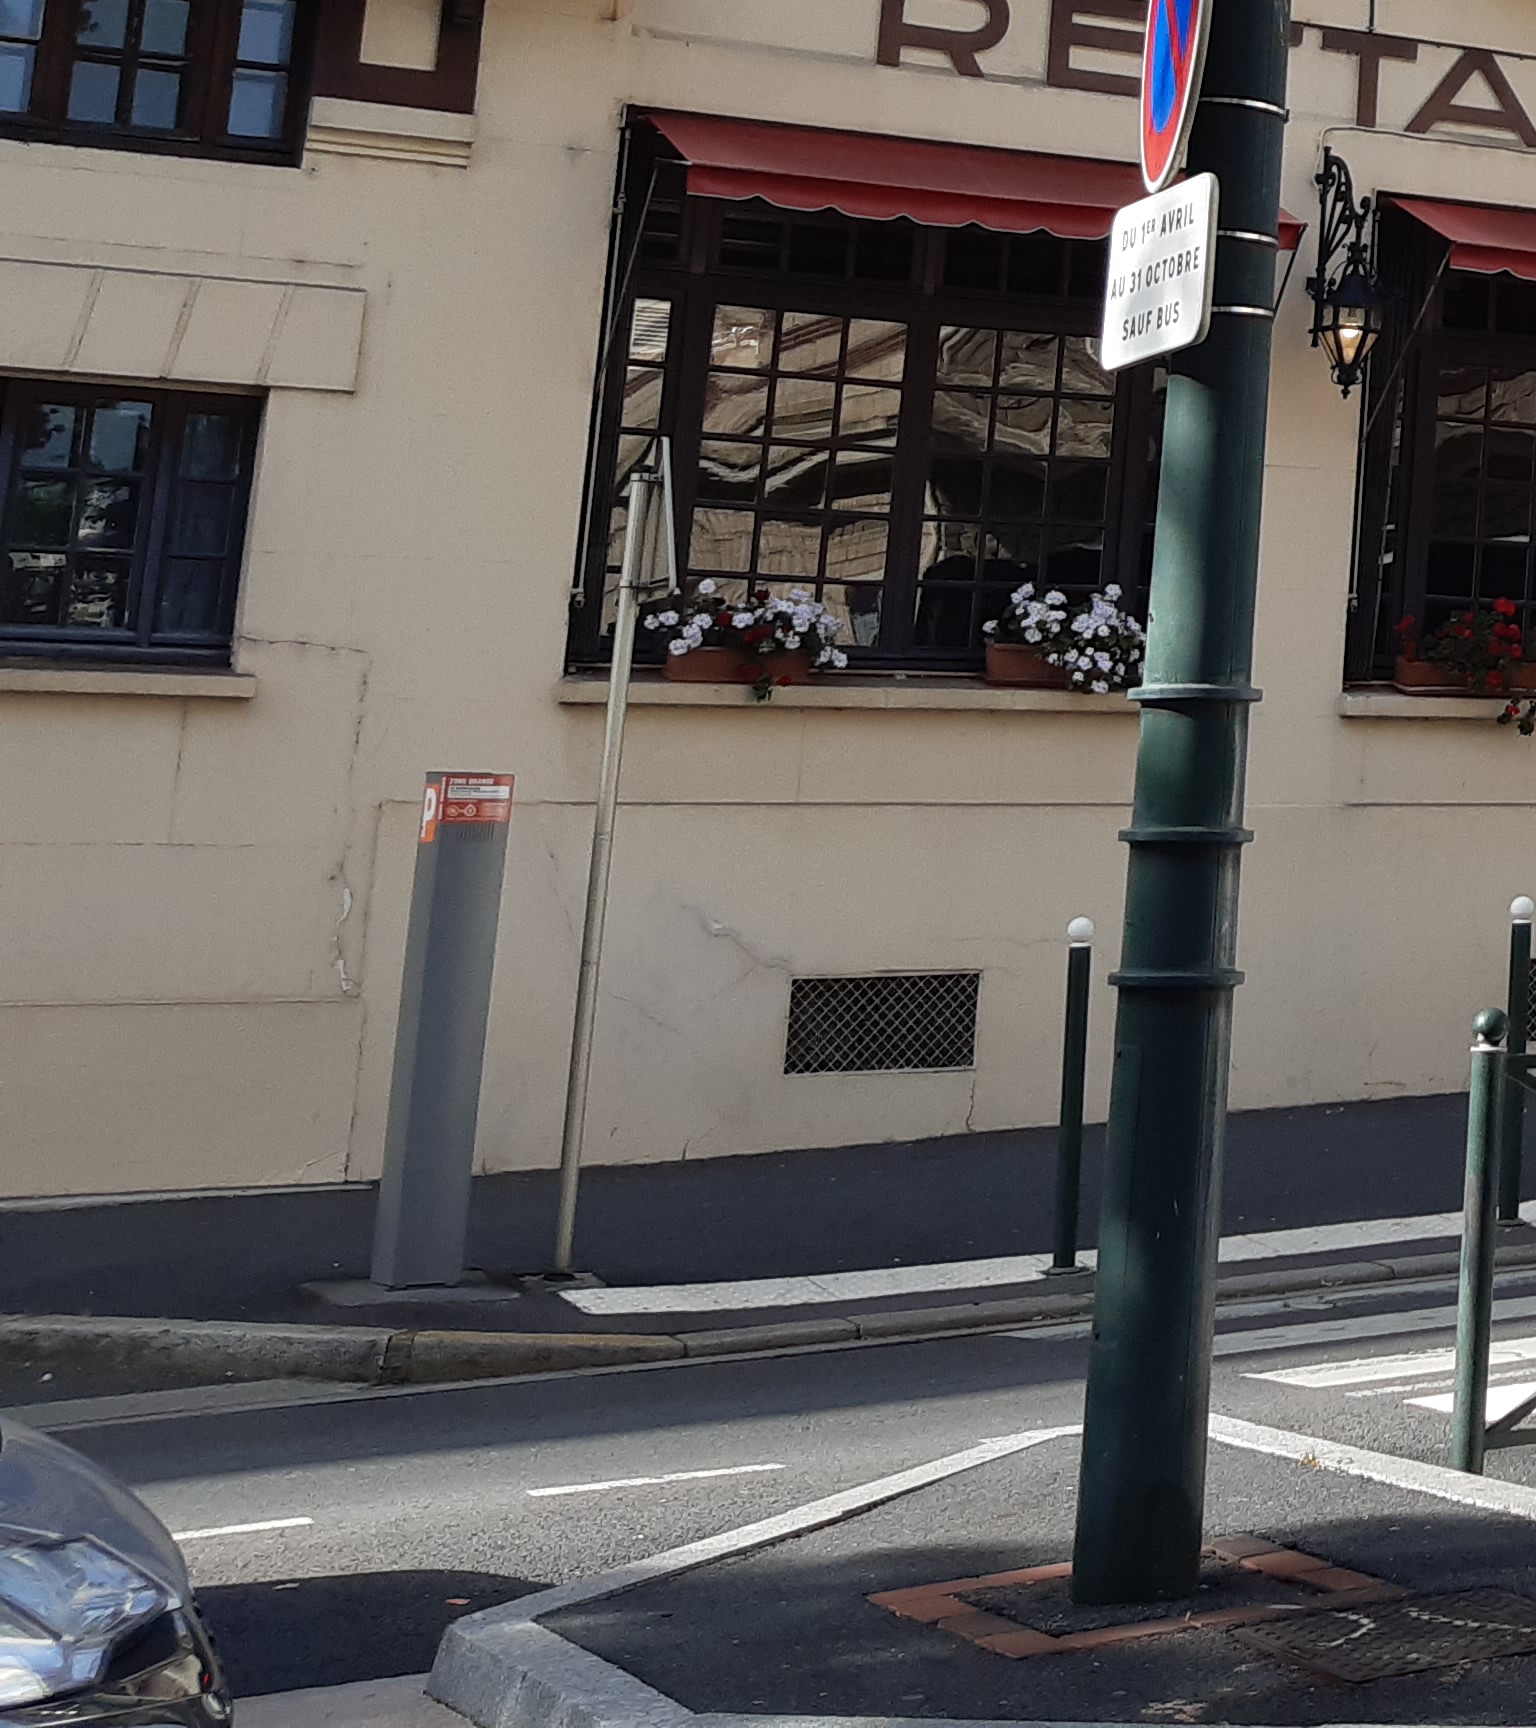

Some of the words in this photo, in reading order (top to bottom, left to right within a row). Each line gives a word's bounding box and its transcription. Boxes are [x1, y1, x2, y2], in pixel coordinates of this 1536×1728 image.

[1121, 229, 1137, 252] DU
[1160, 203, 1194, 237] AVRIL
[1110, 277, 1126, 300] AU
[1129, 269, 1143, 294] 31
[1145, 247, 1200, 287] OCTOBRE
[1121, 311, 1152, 342] SAUF
[1156, 300, 1180, 330] BUS
